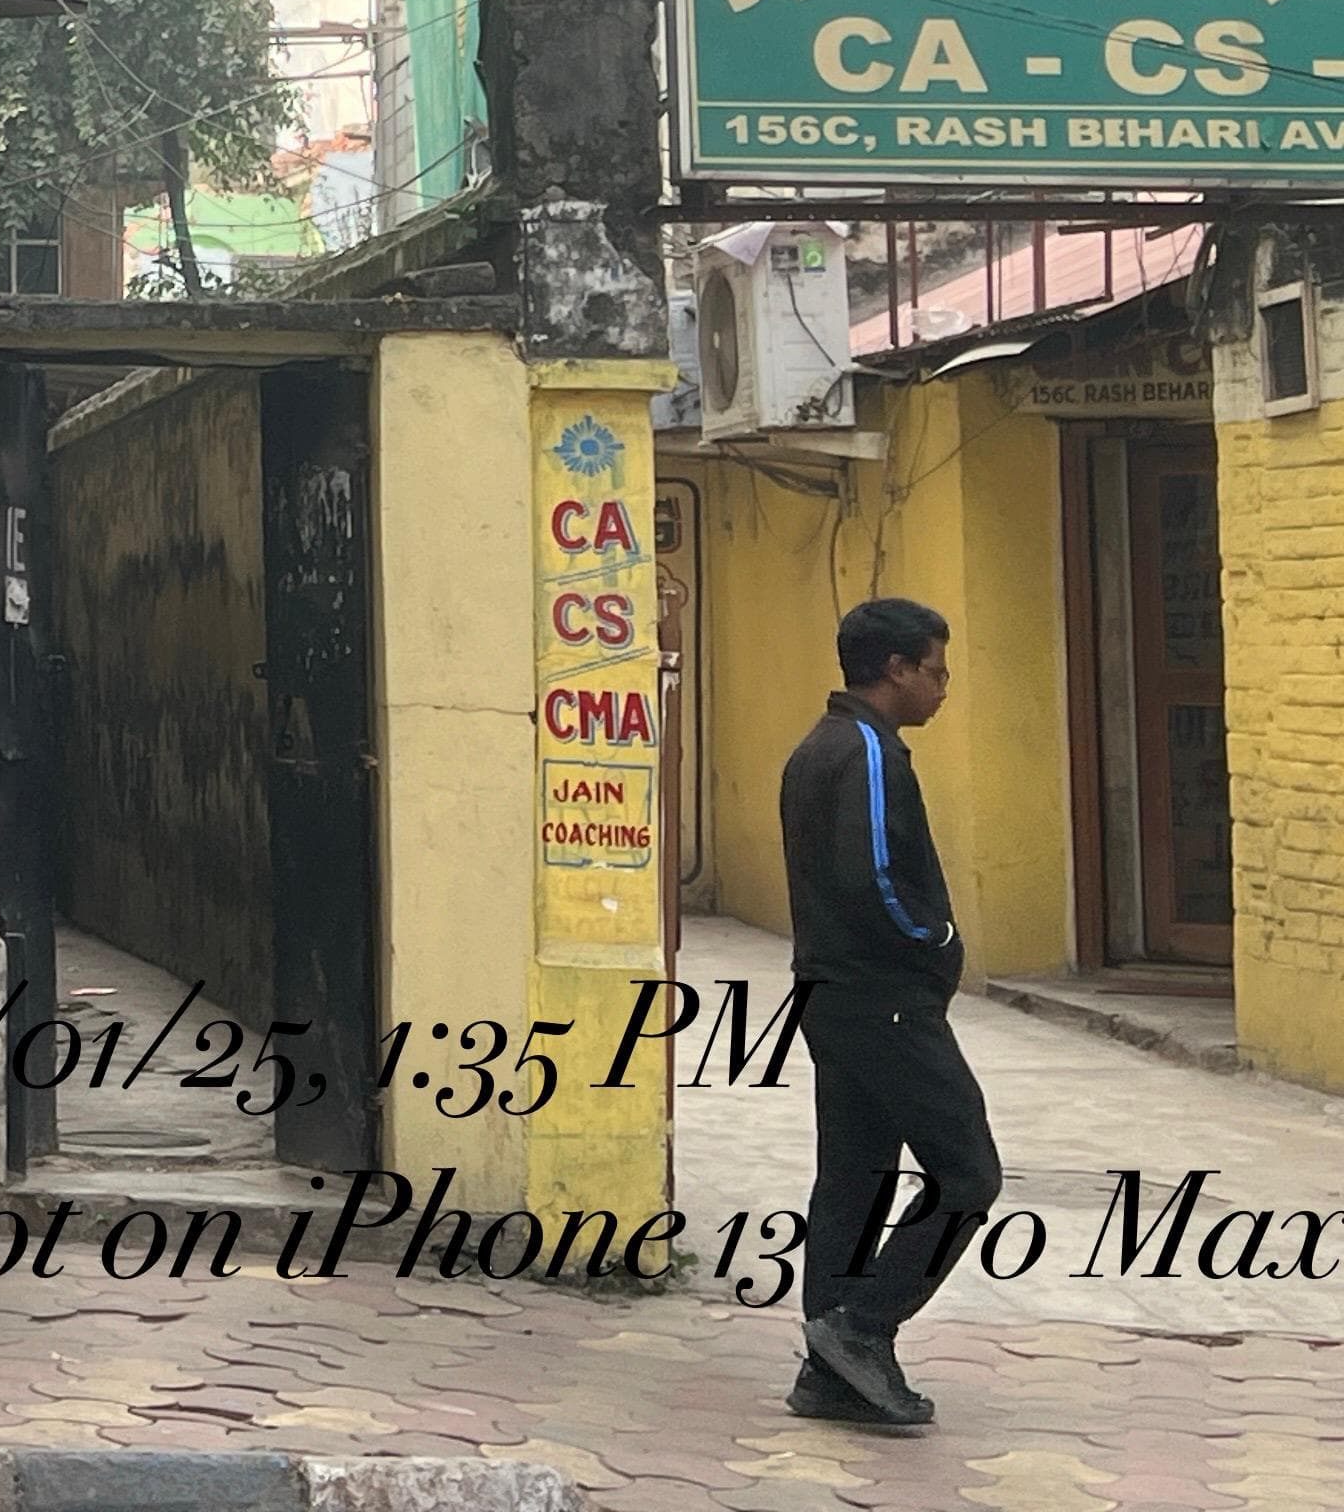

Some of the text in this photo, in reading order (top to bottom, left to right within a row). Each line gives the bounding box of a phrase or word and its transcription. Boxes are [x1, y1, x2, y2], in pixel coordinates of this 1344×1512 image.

[813, 17, 988, 93] CA
[1104, 19, 1271, 96] CS
[725, 115, 1344, 153] 156C, RASH BEHARI AV
[1084, 383, 1136, 403] RASH
[551, 500, 634, 554] CA
[552, 592, 634, 649] CS
[544, 689, 656, 746] CMA
[553, 779, 624, 804] JAIN
[542, 821, 651, 849] COACHING
